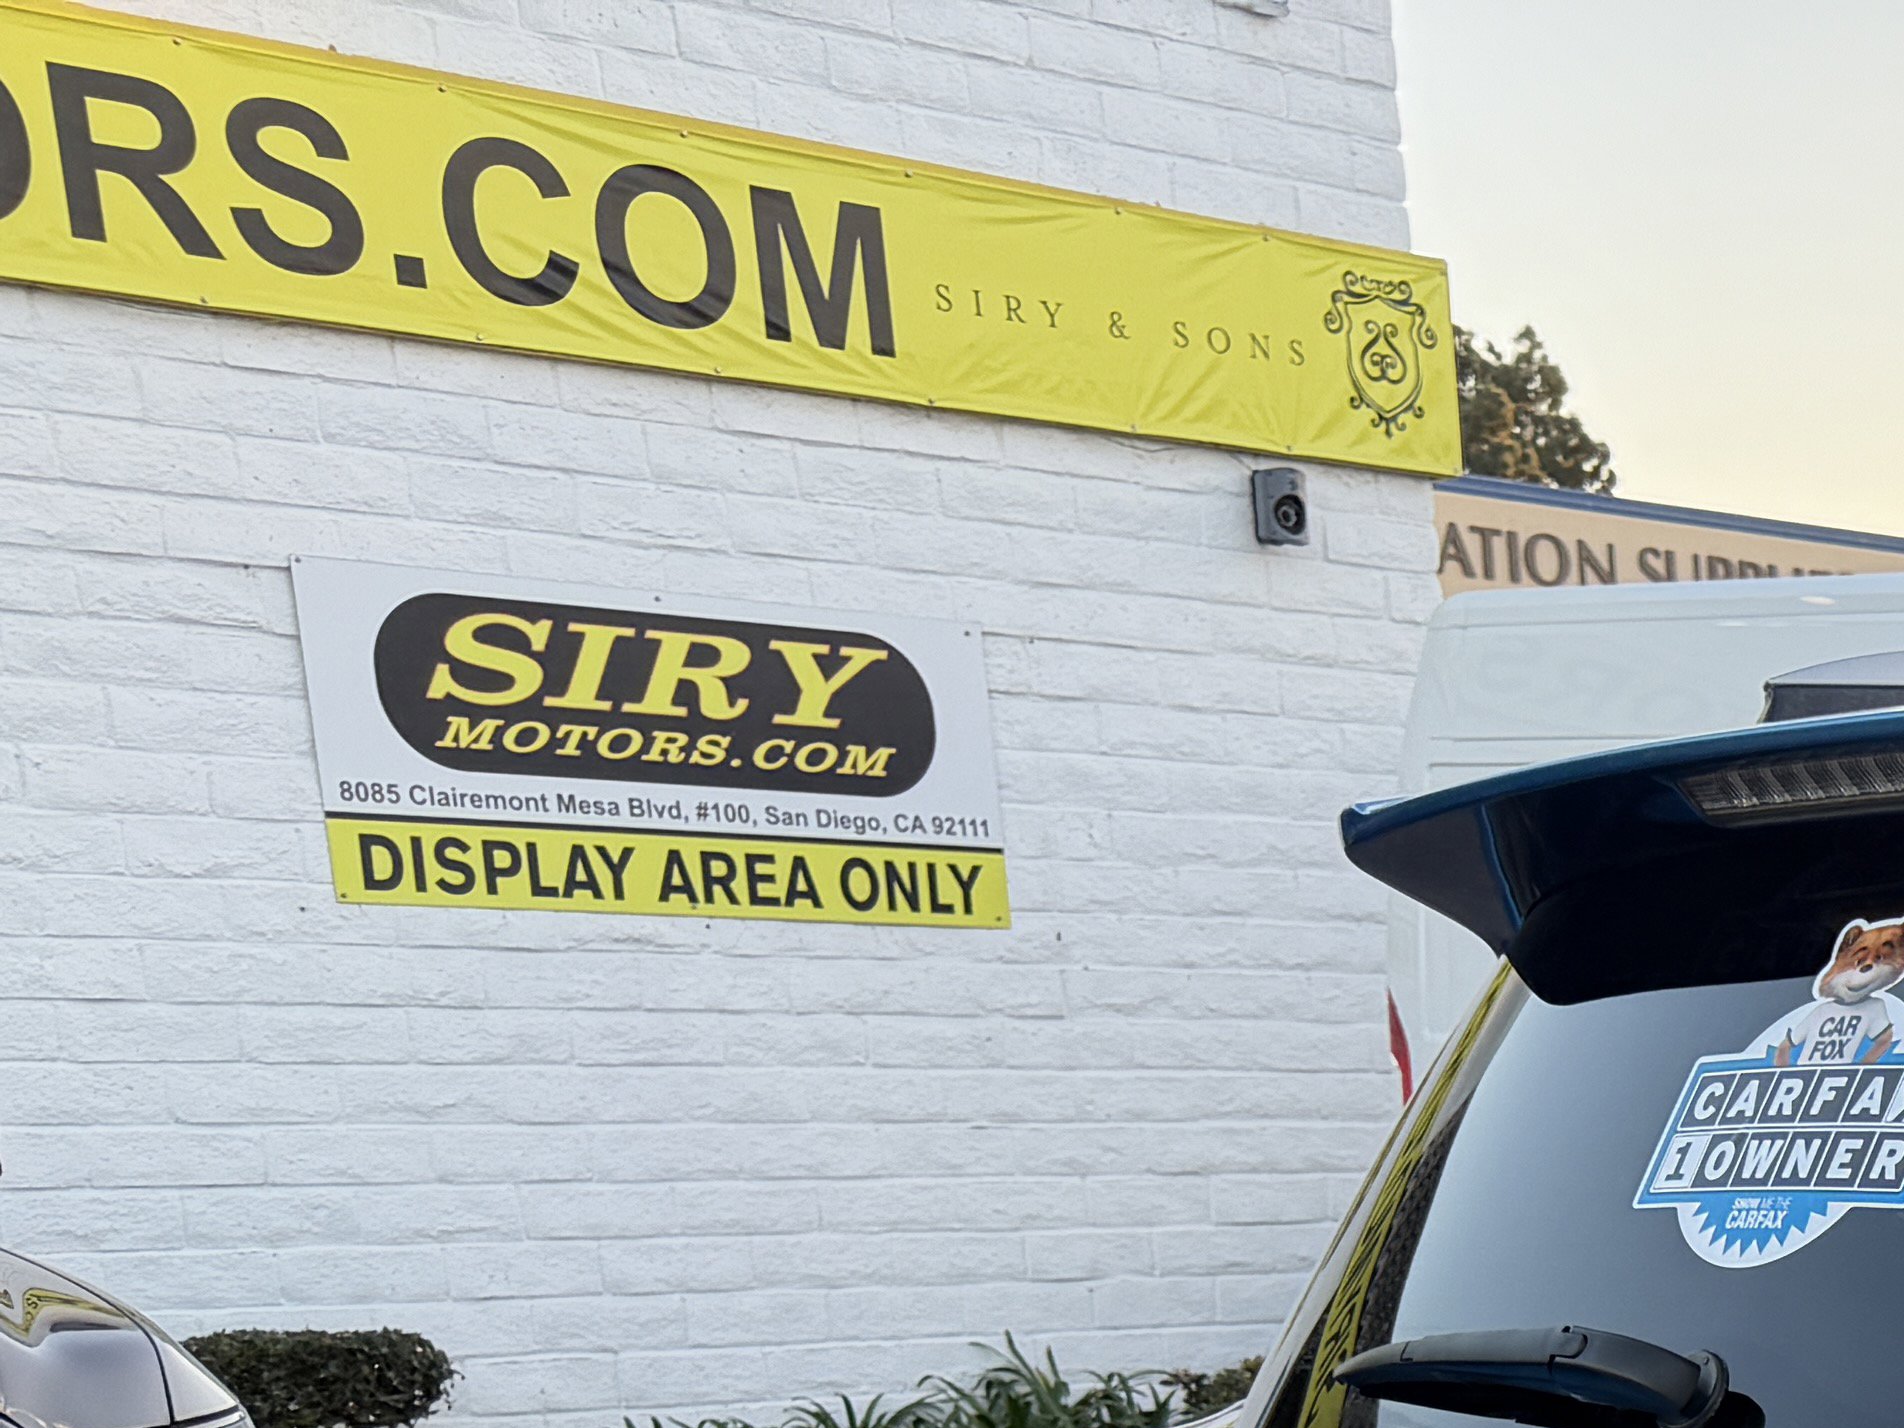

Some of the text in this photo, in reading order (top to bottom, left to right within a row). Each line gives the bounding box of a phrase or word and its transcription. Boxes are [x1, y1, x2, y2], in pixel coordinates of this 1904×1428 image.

[0, 59, 898, 359] RS.COM
[933, 281, 1307, 368] SIRY & SONS
[1437, 521, 1619, 587] ATION
[425, 612, 890, 730] SIRY
[434, 716, 897, 778] MOTORS.COM
[339, 780, 990, 838] 8085 Clairemont Mesa Blvd, #100, San Diego, CA 92111
[358, 832, 984, 916] DISPLAY AREA ONLY
[1808, 1037, 1851, 1062] FOX
[1818, 1014, 1862, 1039] CAR
[1725, 1209, 1788, 1229] CARFAX
